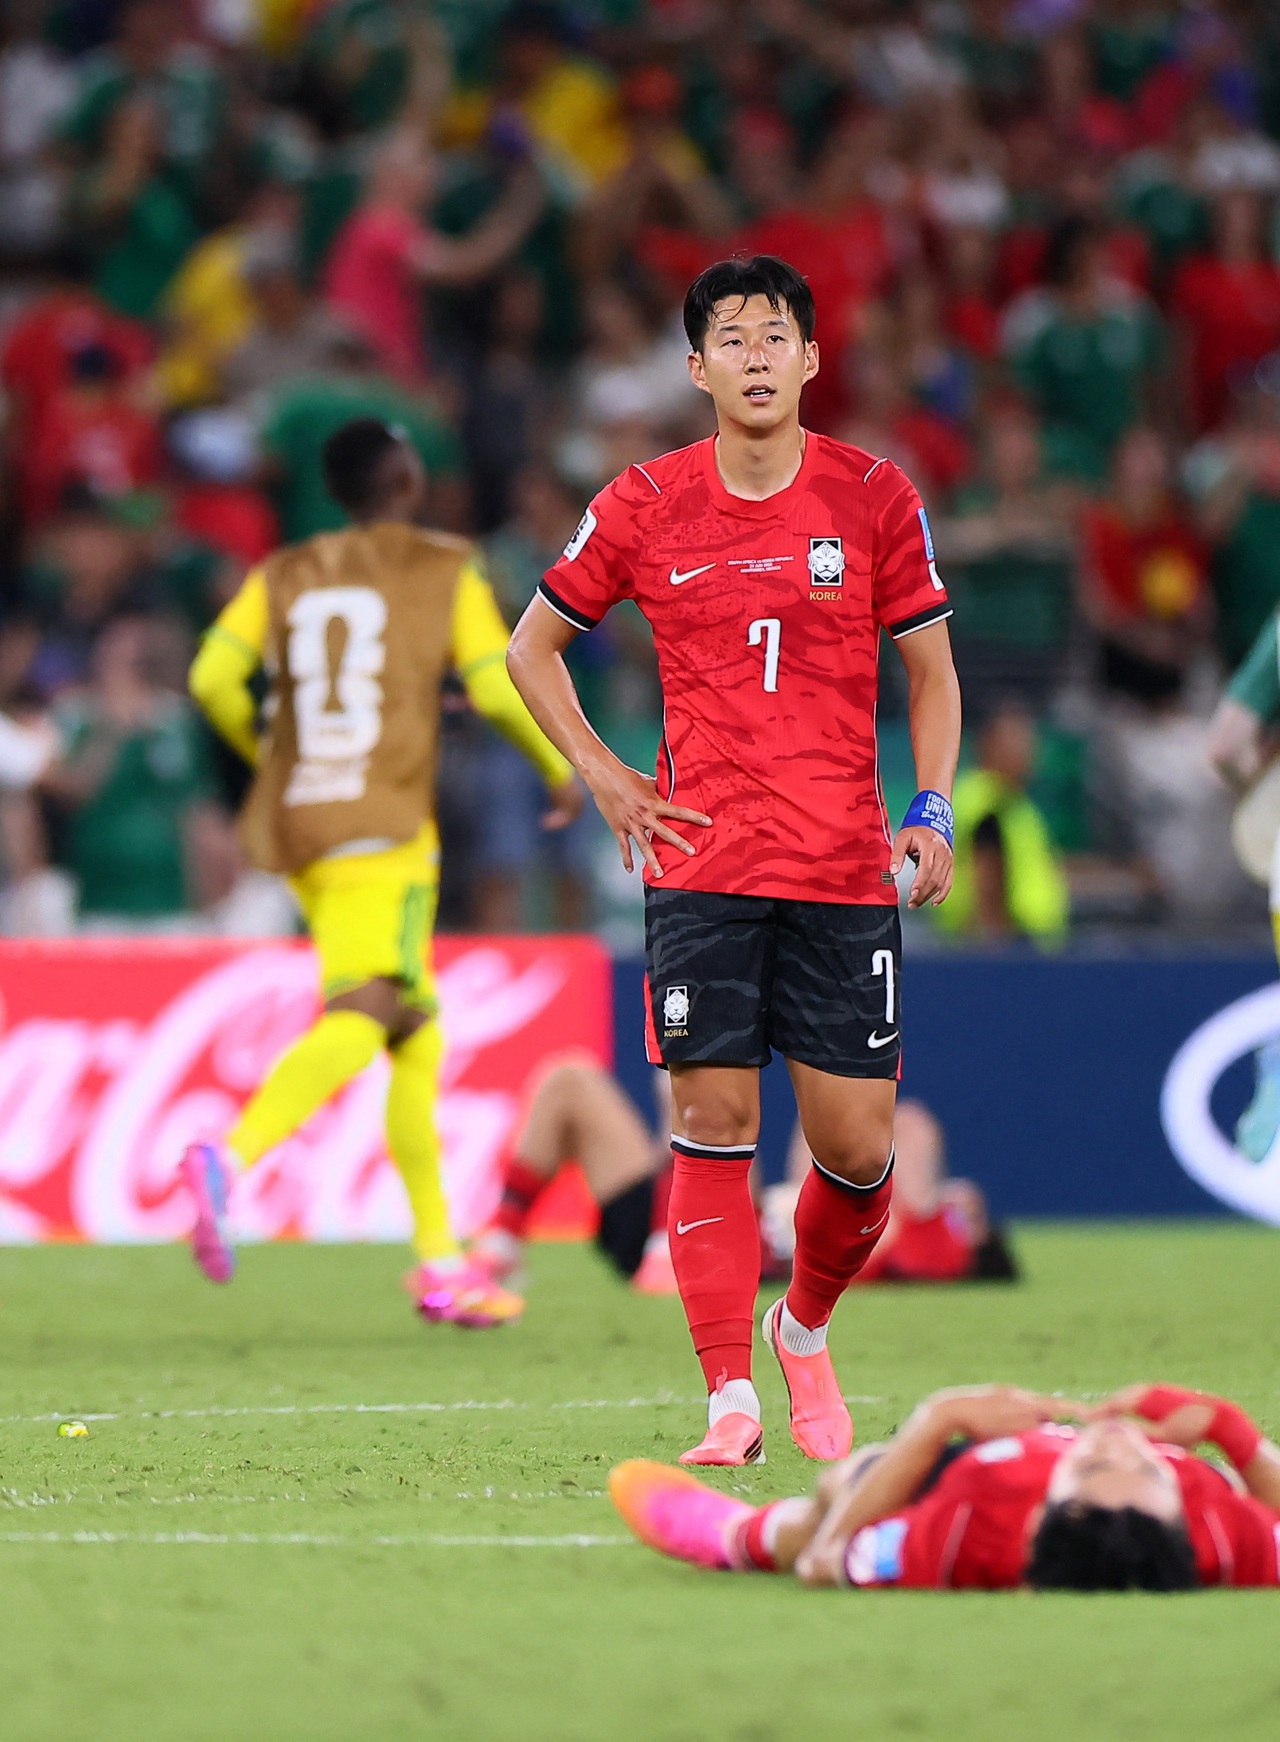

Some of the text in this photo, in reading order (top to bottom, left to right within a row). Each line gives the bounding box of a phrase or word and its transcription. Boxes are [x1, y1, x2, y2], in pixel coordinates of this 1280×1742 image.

[809, 591, 843, 601] KOREA
[747, 617, 781, 692] 7
[925, 800, 953, 823] UNITE
[928, 793, 952, 811] FOOTB
[871, 949, 895, 1024] 7
[663, 1028, 689, 1037] KOREA
